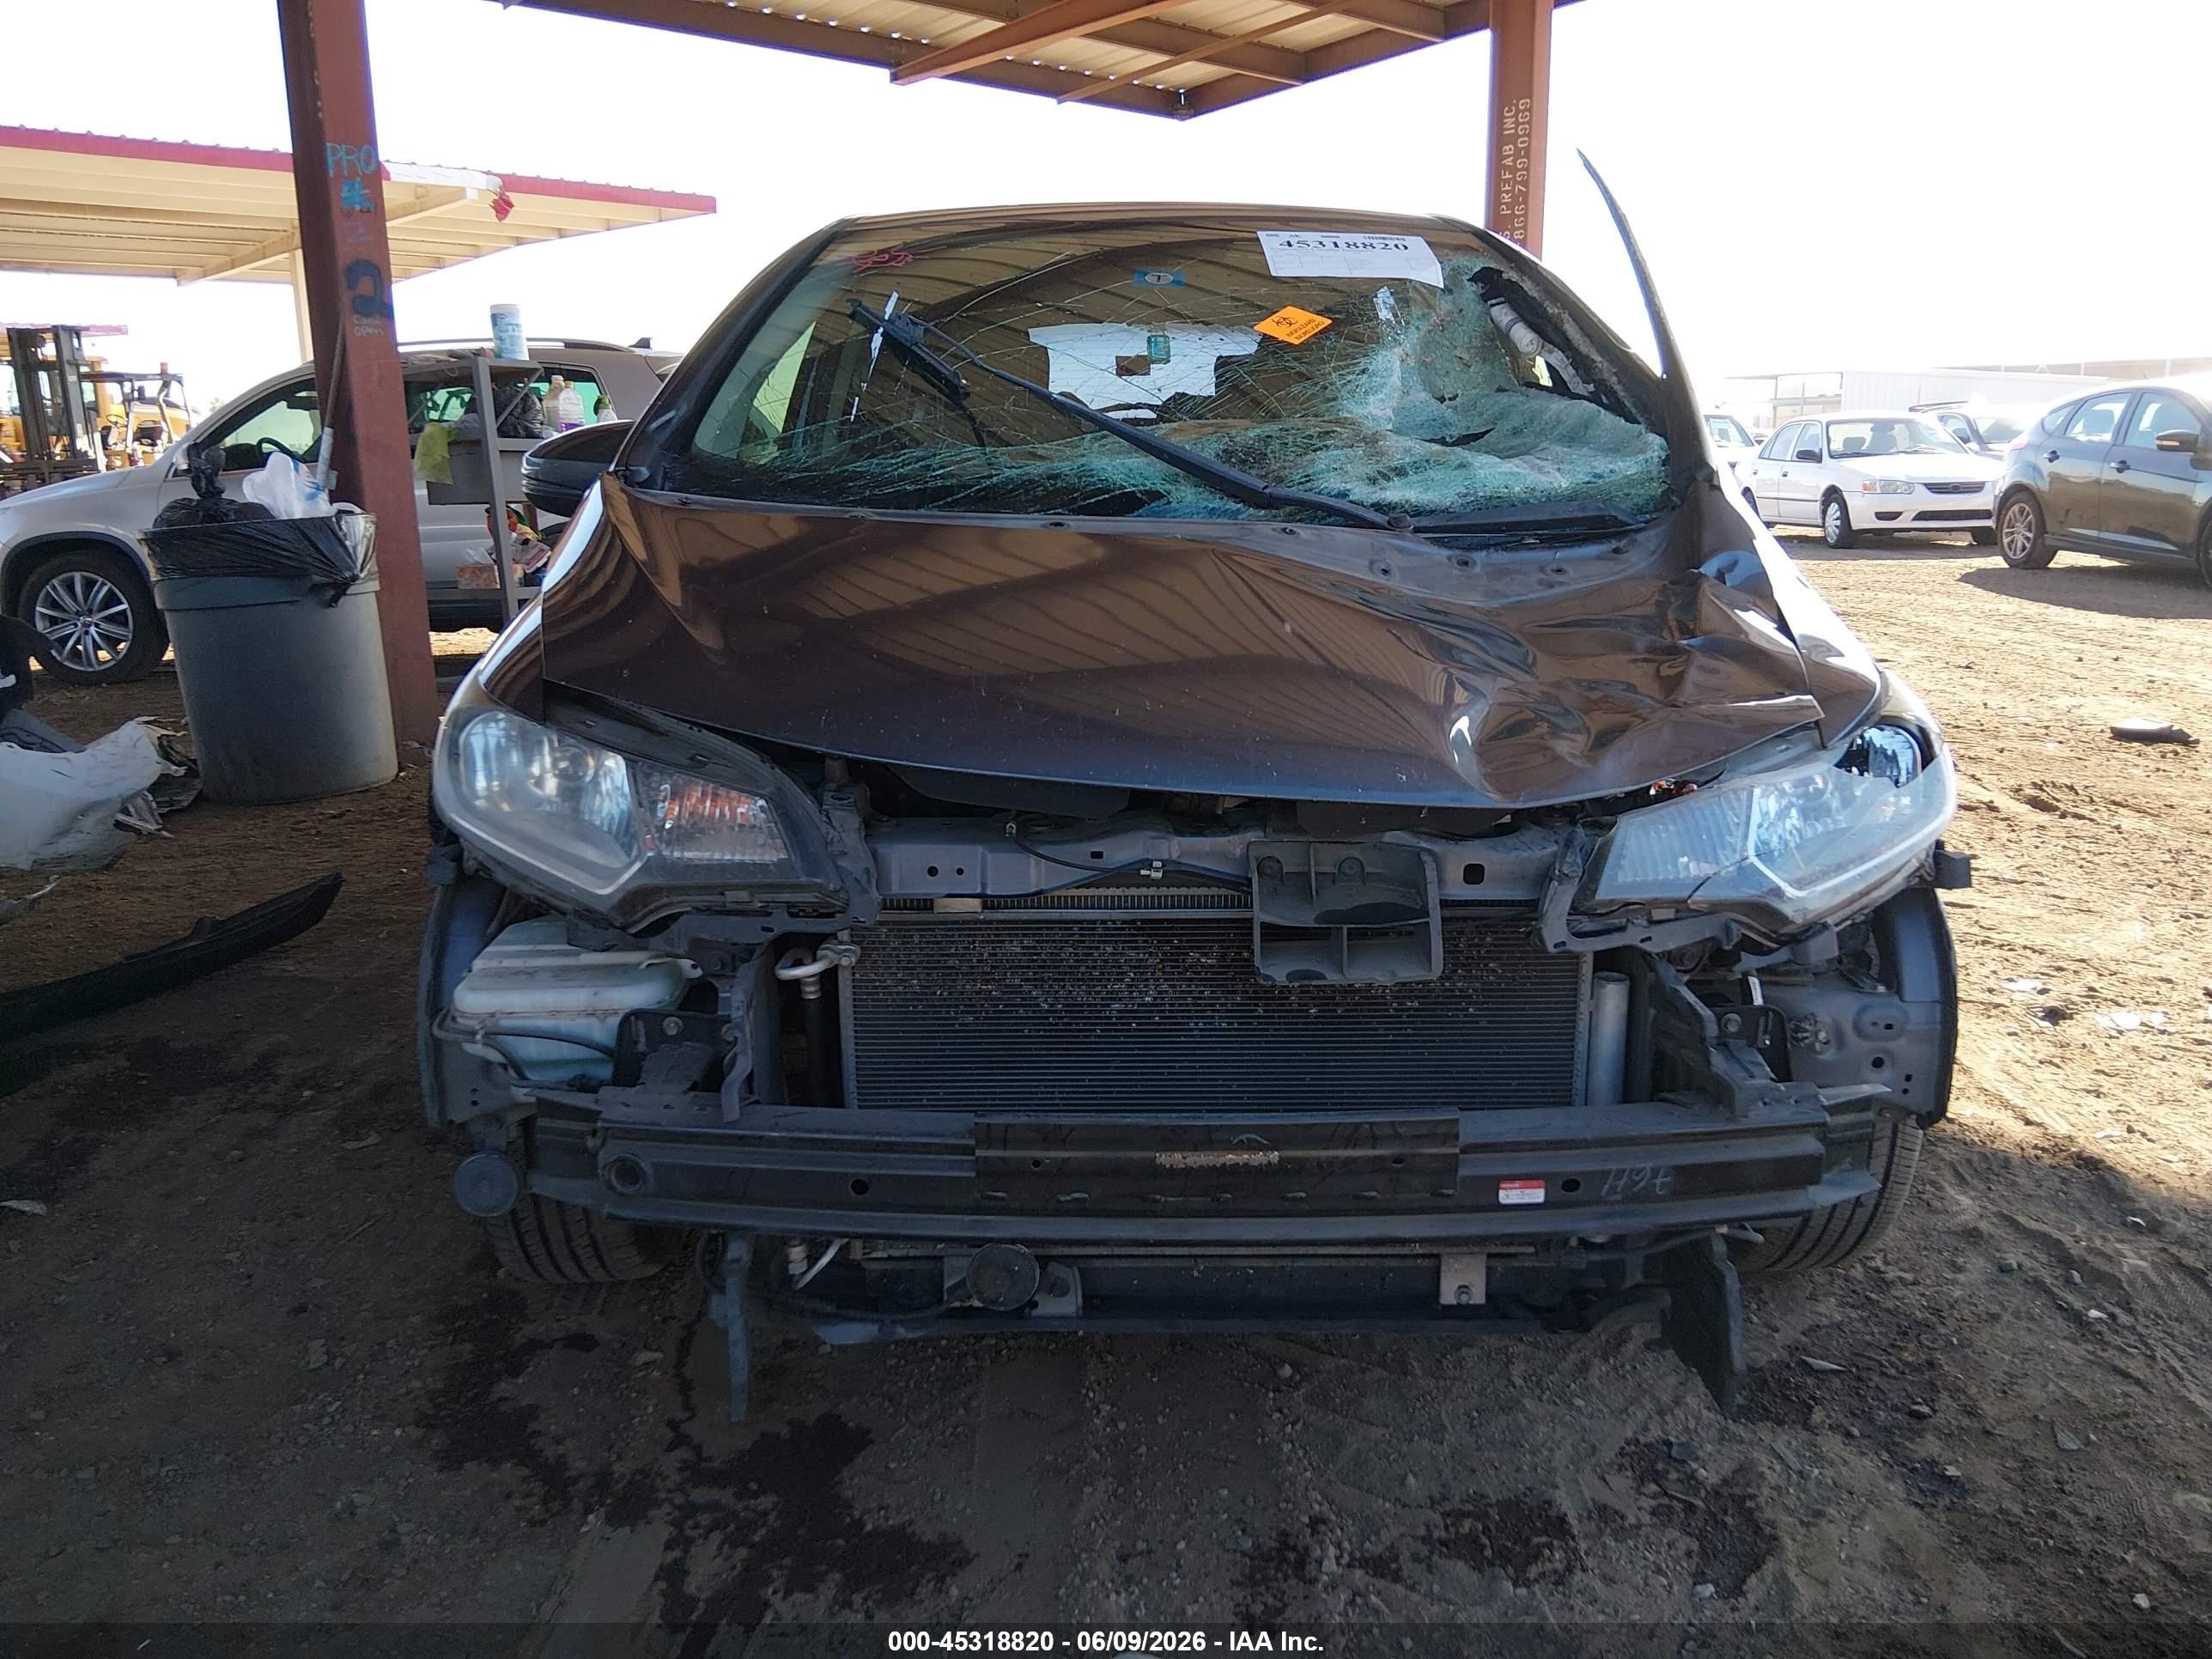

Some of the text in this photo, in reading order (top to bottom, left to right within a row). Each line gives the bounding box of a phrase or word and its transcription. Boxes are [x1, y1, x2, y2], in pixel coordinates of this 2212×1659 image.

[1504, 99, 1517, 135] INC.
[325, 143, 378, 178] PRO
[1500, 144, 1514, 215] PREFAB
[1279, 240, 1409, 251] 45318820
[345, 259, 394, 318] 2
